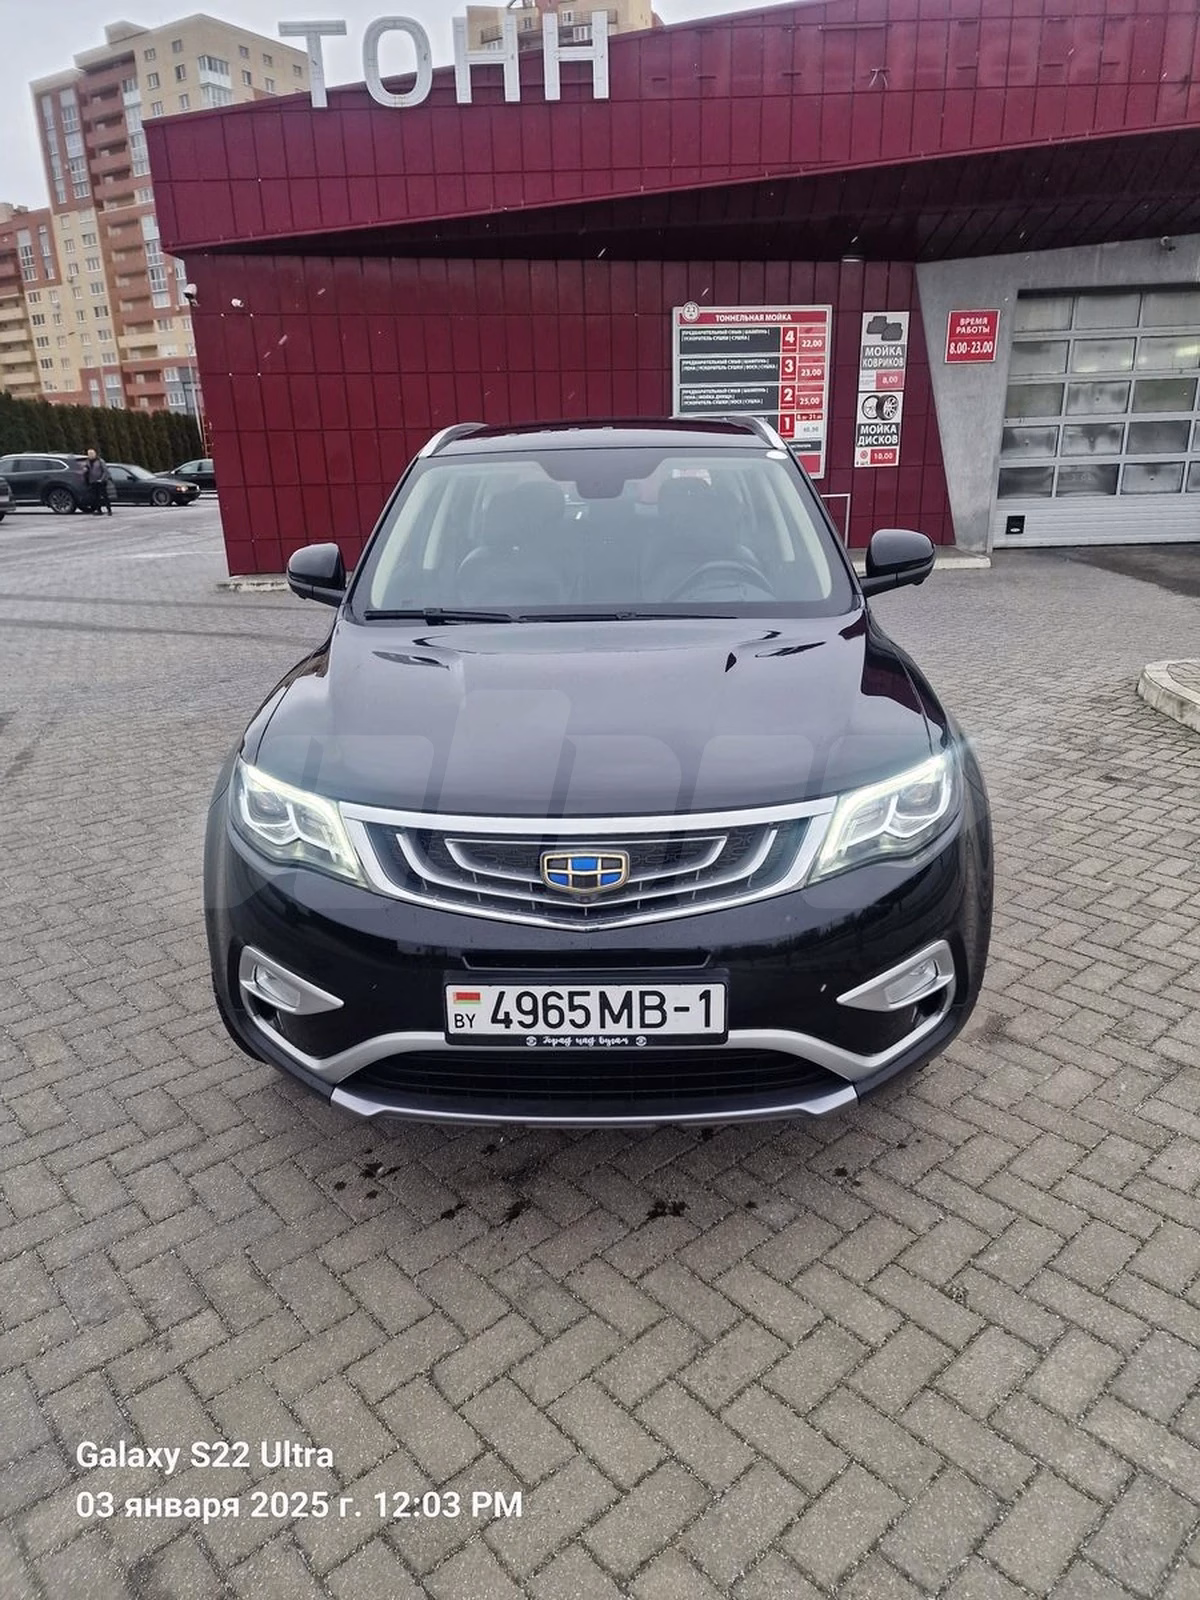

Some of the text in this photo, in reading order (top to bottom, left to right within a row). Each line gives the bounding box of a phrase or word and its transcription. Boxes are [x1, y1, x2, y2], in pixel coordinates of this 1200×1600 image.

[278, 10, 610, 108] ТОНН
[715, 313, 792, 323] ТОННЕЛЬНАЯ МОЙКА
[960, 317, 988, 326] ВРЕМЯ
[956, 325, 990, 334] РАБОТЫ
[785, 330, 795, 344] 4
[864, 346, 903, 357] МОЙКА
[784, 359, 794, 373] 3
[862, 357, 904, 368] КОВРИКОВ
[783, 388, 793, 401] 2
[784, 417, 790, 430] 1
[860, 423, 897, 435] МОЙКА
[857, 434, 898, 446] ДИСКОВ
[454, 989, 712, 1029] BY 4965MB-1
